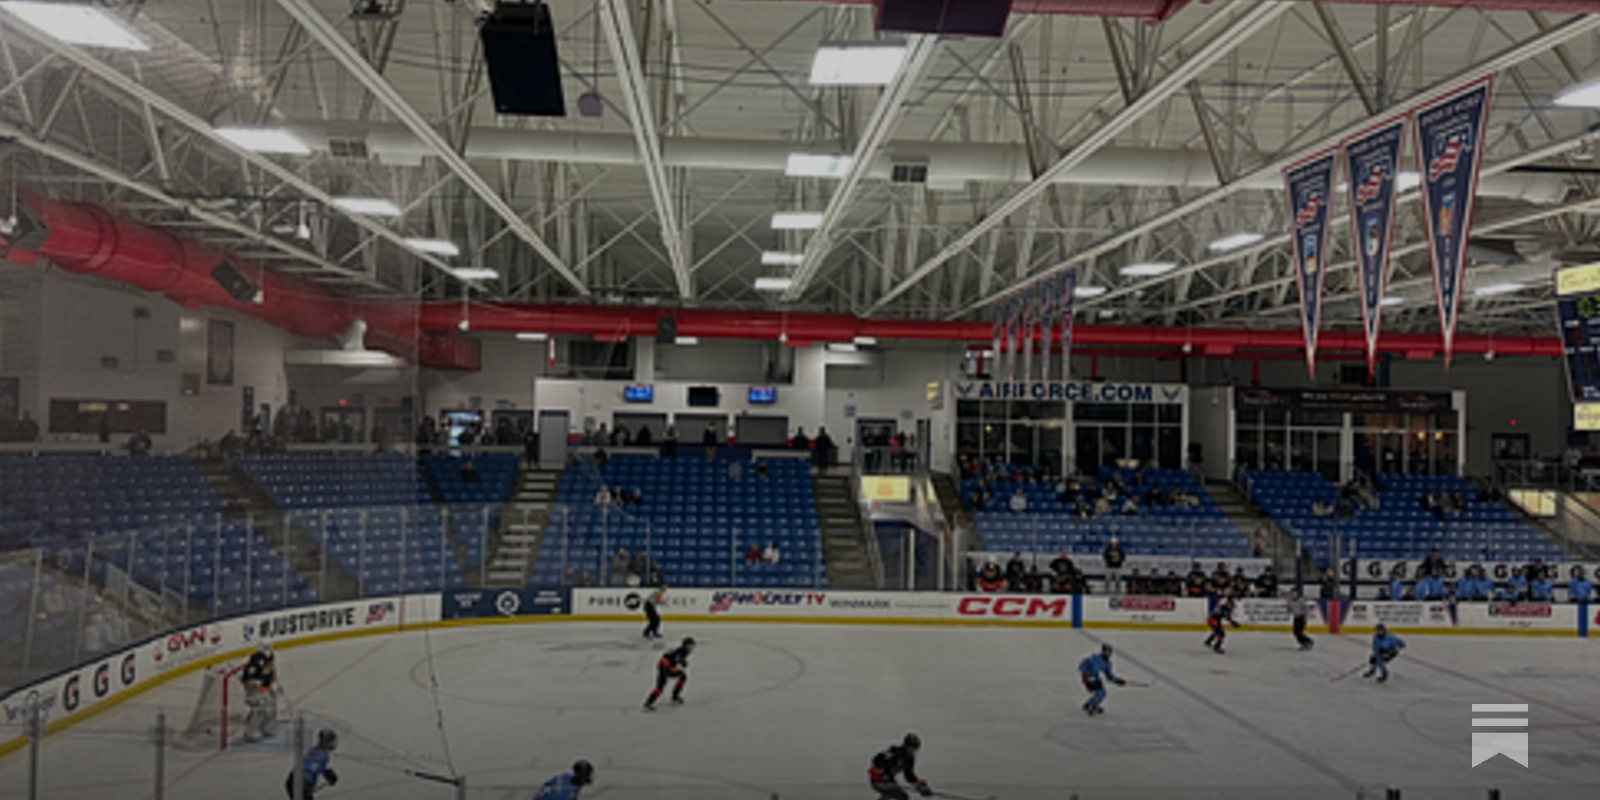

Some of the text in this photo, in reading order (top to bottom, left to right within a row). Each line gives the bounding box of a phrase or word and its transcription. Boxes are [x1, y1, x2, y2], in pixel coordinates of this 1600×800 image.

[980, 383, 1153, 400] AIRFORCE.COM
[957, 597, 1067, 617] CCM
[259, 607, 355, 638] #JUSTDRIVE
[64, 674, 79, 711] G
[94, 663, 109, 697] G
[121, 653, 135, 685] G
